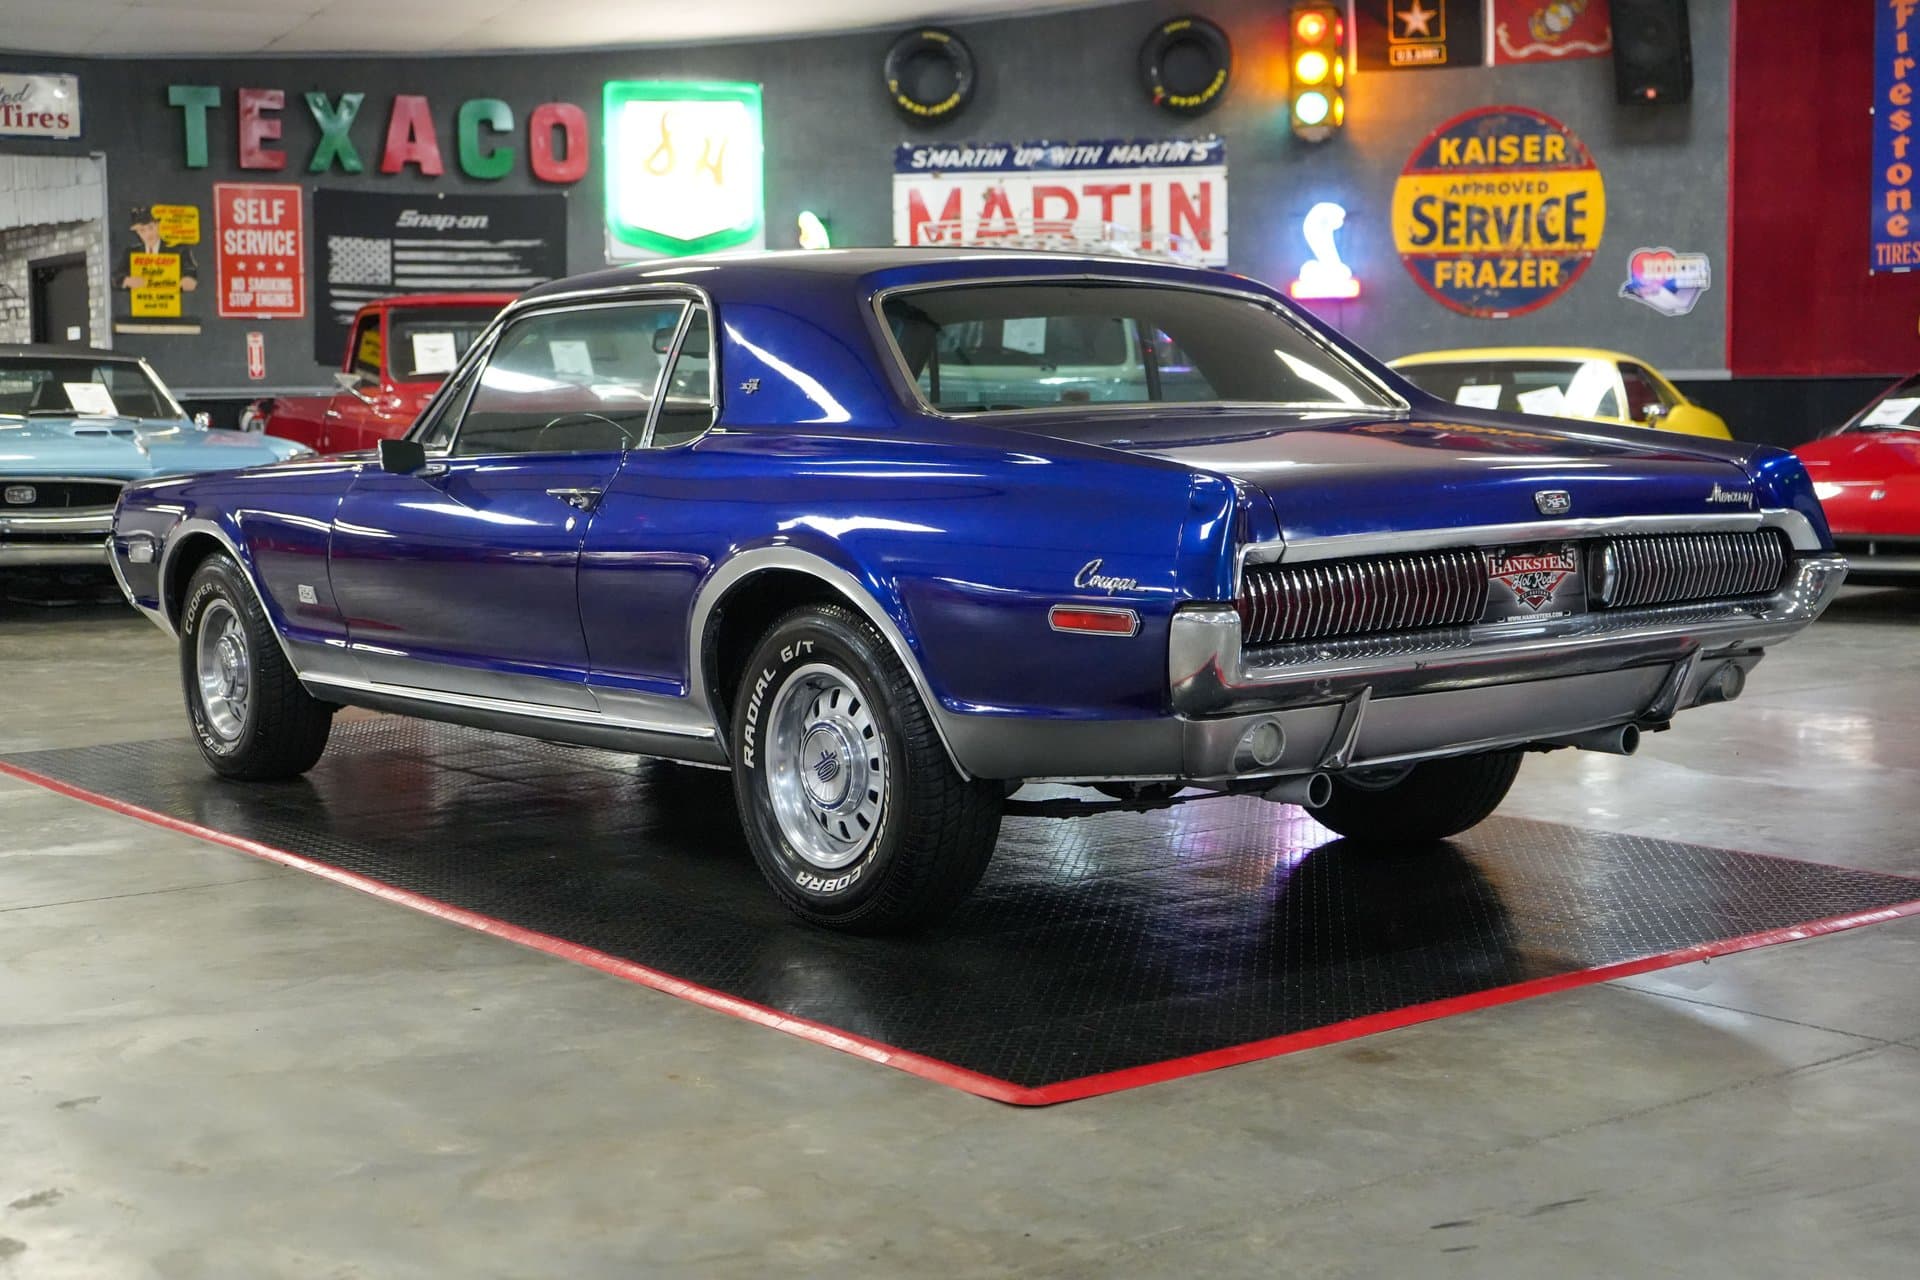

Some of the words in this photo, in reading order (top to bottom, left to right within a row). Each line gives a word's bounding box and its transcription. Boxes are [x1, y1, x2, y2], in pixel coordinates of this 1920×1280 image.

[0, 104, 69, 129] Tires
[168, 85, 589, 183] TEXACO
[1014, 148, 1042, 167] UP
[1052, 146, 1101, 165] WITH
[1438, 134, 1567, 166] KAISER
[1450, 181, 1549, 196] APPROVED
[233, 197, 285, 225] SELF
[396, 209, 489, 231] Snap-on
[908, 181, 1212, 252] MARTIN
[1409, 190, 1588, 246] SERVICE
[224, 229, 296, 256] SERVICE
[1875, 240, 1920, 266] TIRES
[231, 277, 246, 292] NO
[248, 277, 293, 292] SMOKING
[1434, 259, 1560, 288] FRAZER
[229, 292, 253, 307] STOP
[255, 292, 294, 307] ENGINES
[1705, 481, 1753, 509] Mercury
[1074, 559, 1137, 596] Cougar
[1512, 573, 1532, 589] Hot
[185, 583, 213, 635] COOPER
[743, 668, 776, 768] RADIAL
[780, 640, 815, 663] G/T
[795, 866, 862, 892] COBRA
